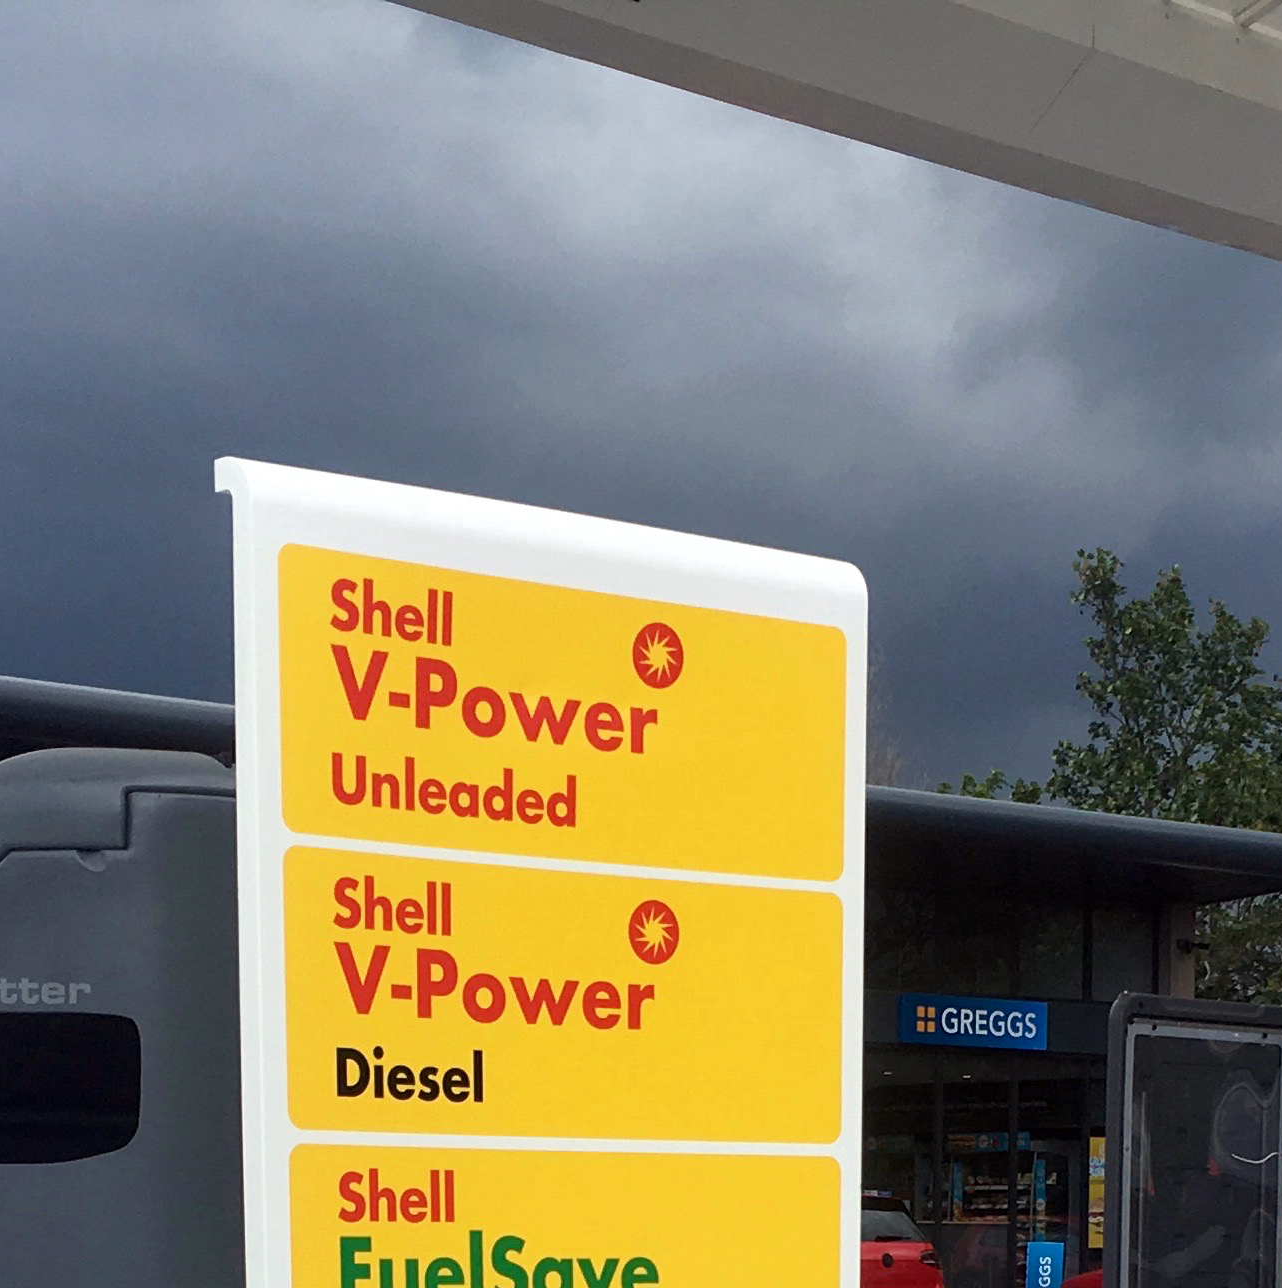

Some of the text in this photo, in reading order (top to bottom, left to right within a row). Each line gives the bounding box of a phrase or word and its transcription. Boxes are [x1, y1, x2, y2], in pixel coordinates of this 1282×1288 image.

[330, 577, 454, 647] Shell
[330, 643, 658, 755] V-Power
[331, 751, 577, 828] Unleaded
[332, 875, 452, 937] Shell
[333, 941, 655, 1030] V-Power
[941, 1007, 1037, 1039] GREGGS
[336, 1045, 484, 1103] Diesel
[338, 1167, 456, 1224] Shell
